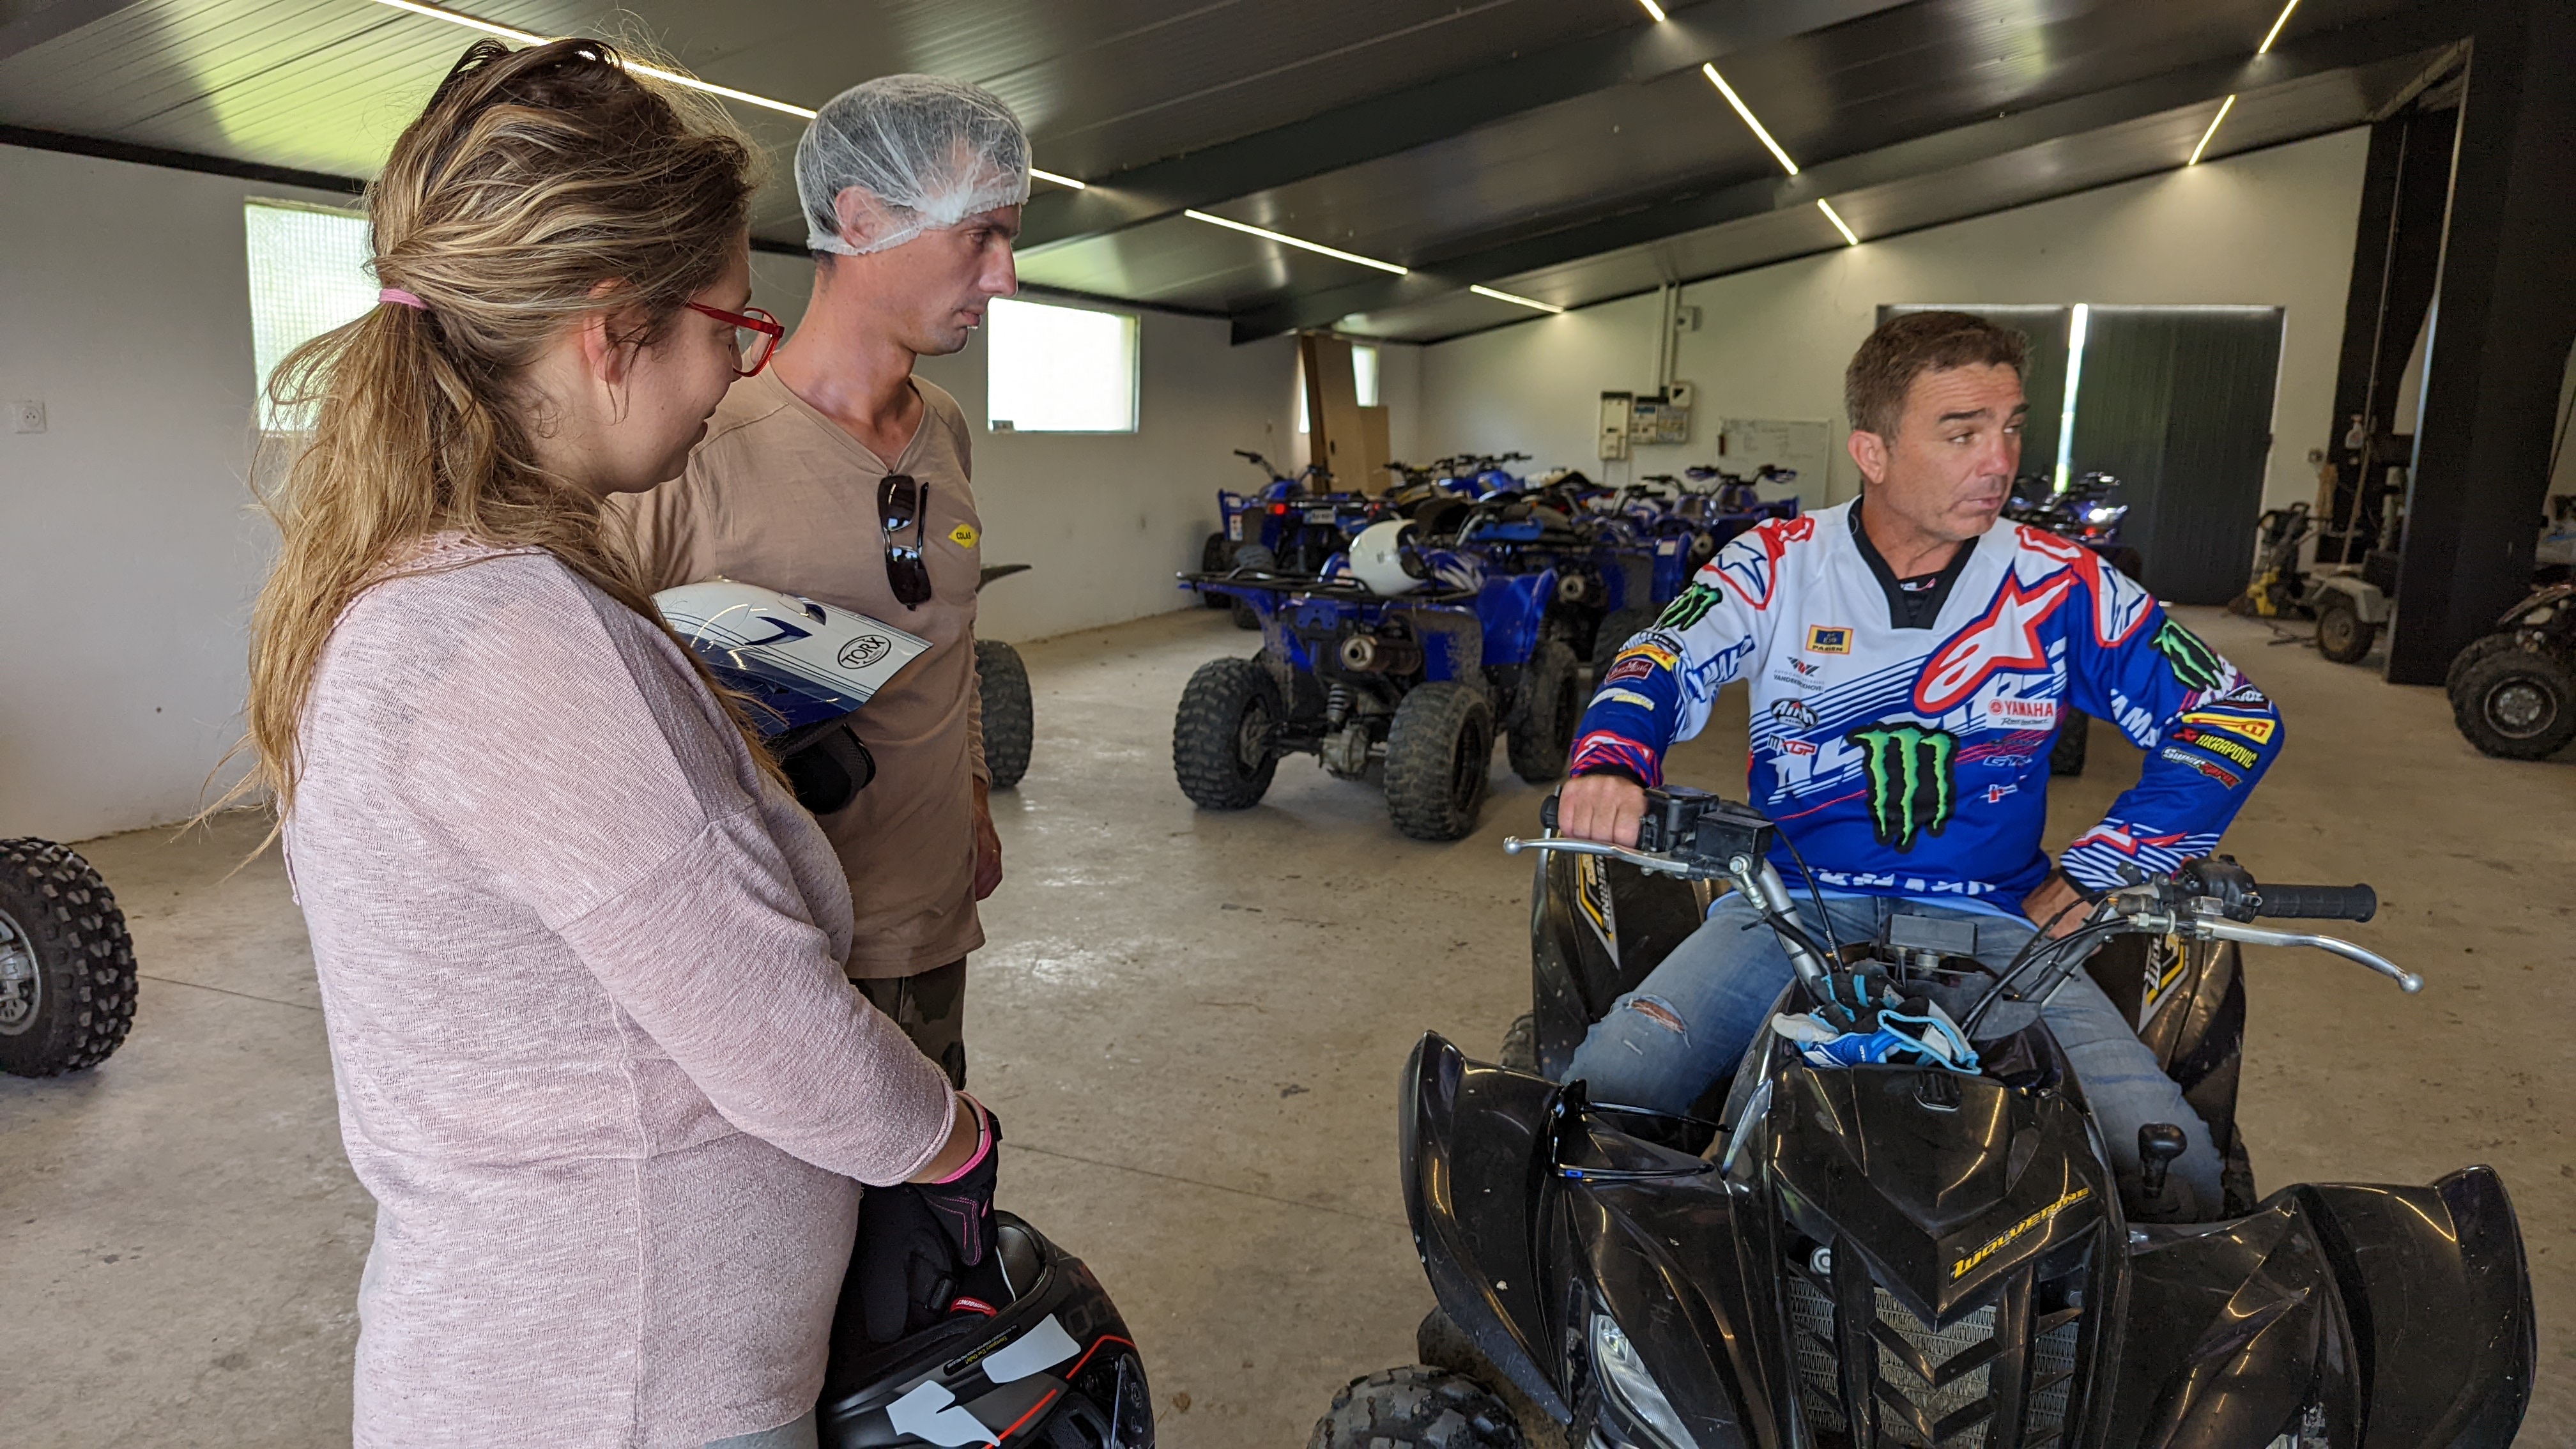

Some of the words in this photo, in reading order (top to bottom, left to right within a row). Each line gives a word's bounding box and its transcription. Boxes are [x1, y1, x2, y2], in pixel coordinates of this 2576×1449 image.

[956, 532, 971, 540] COLAS
[841, 637, 886, 664] TORX
[2004, 700, 2053, 717] YAMAHA
[1768, 734, 1816, 756] MXGP
[1953, 1187, 2089, 1279] WOLVERINE
[987, 1337, 1007, 1350] Emergency
